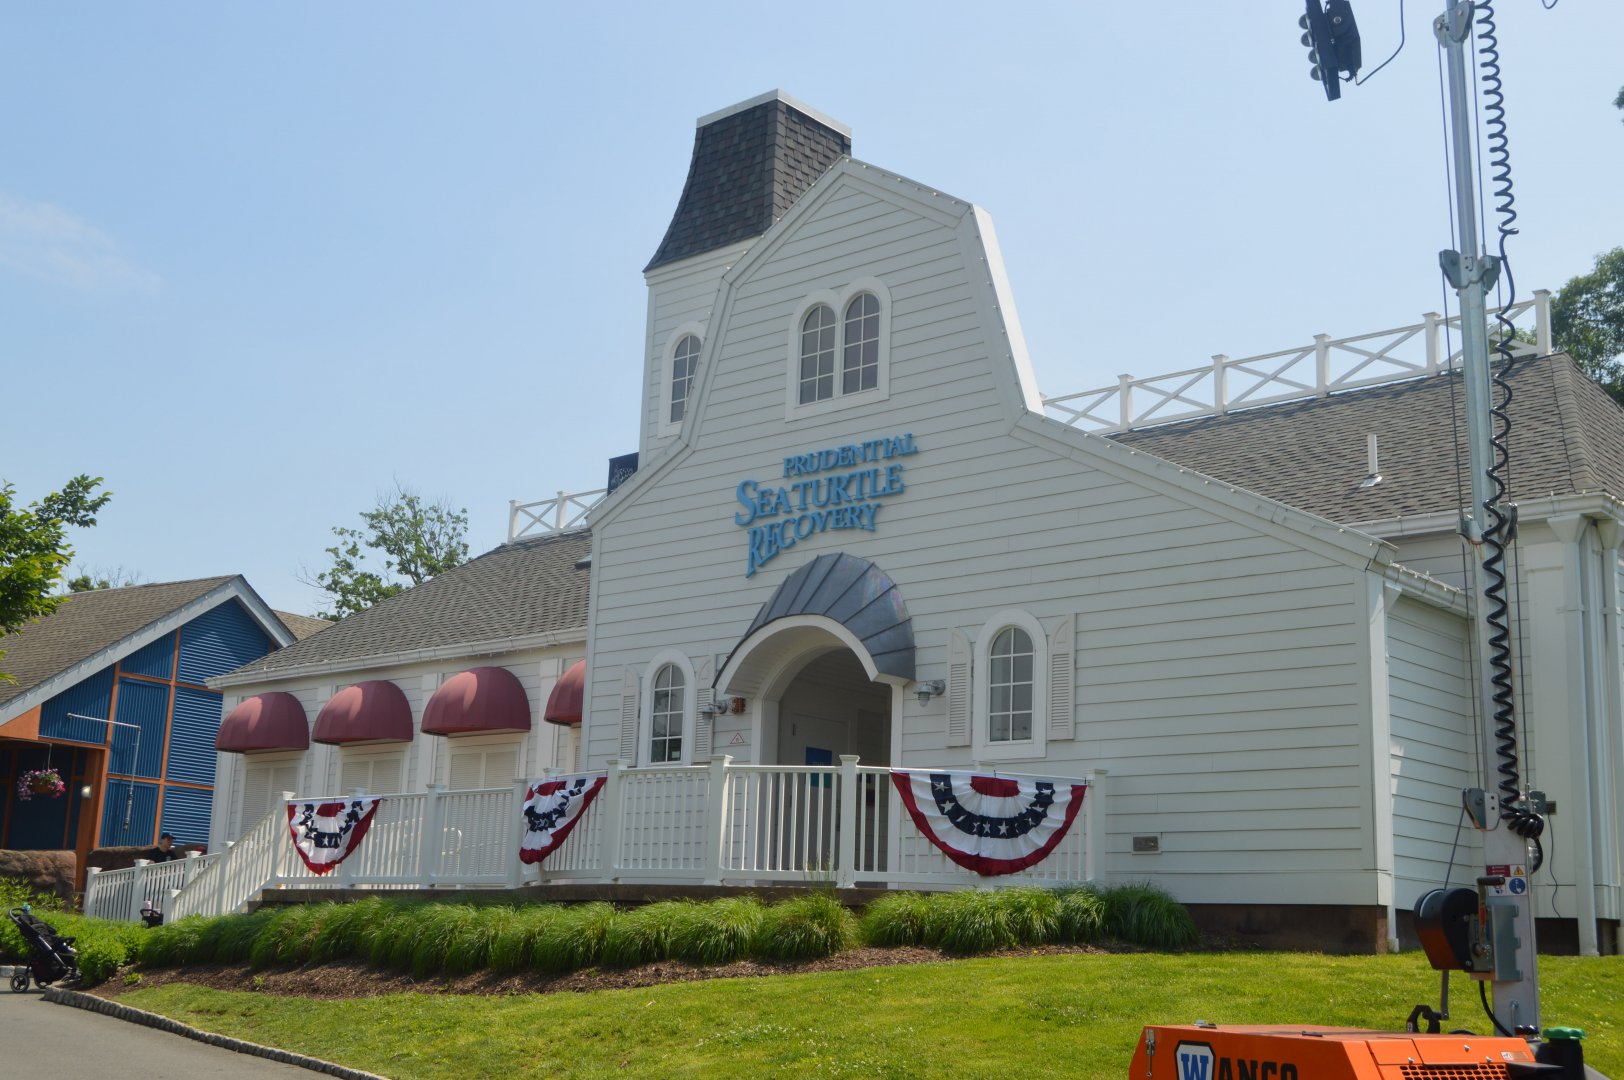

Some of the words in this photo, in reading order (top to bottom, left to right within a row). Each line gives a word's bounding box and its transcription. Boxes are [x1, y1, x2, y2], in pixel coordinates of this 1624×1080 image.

[783, 432, 918, 478] PRUDENTIAL
[735, 479, 793, 525] SEA
[791, 463, 905, 510] TURTLE
[745, 502, 881, 578] RECOVERY
